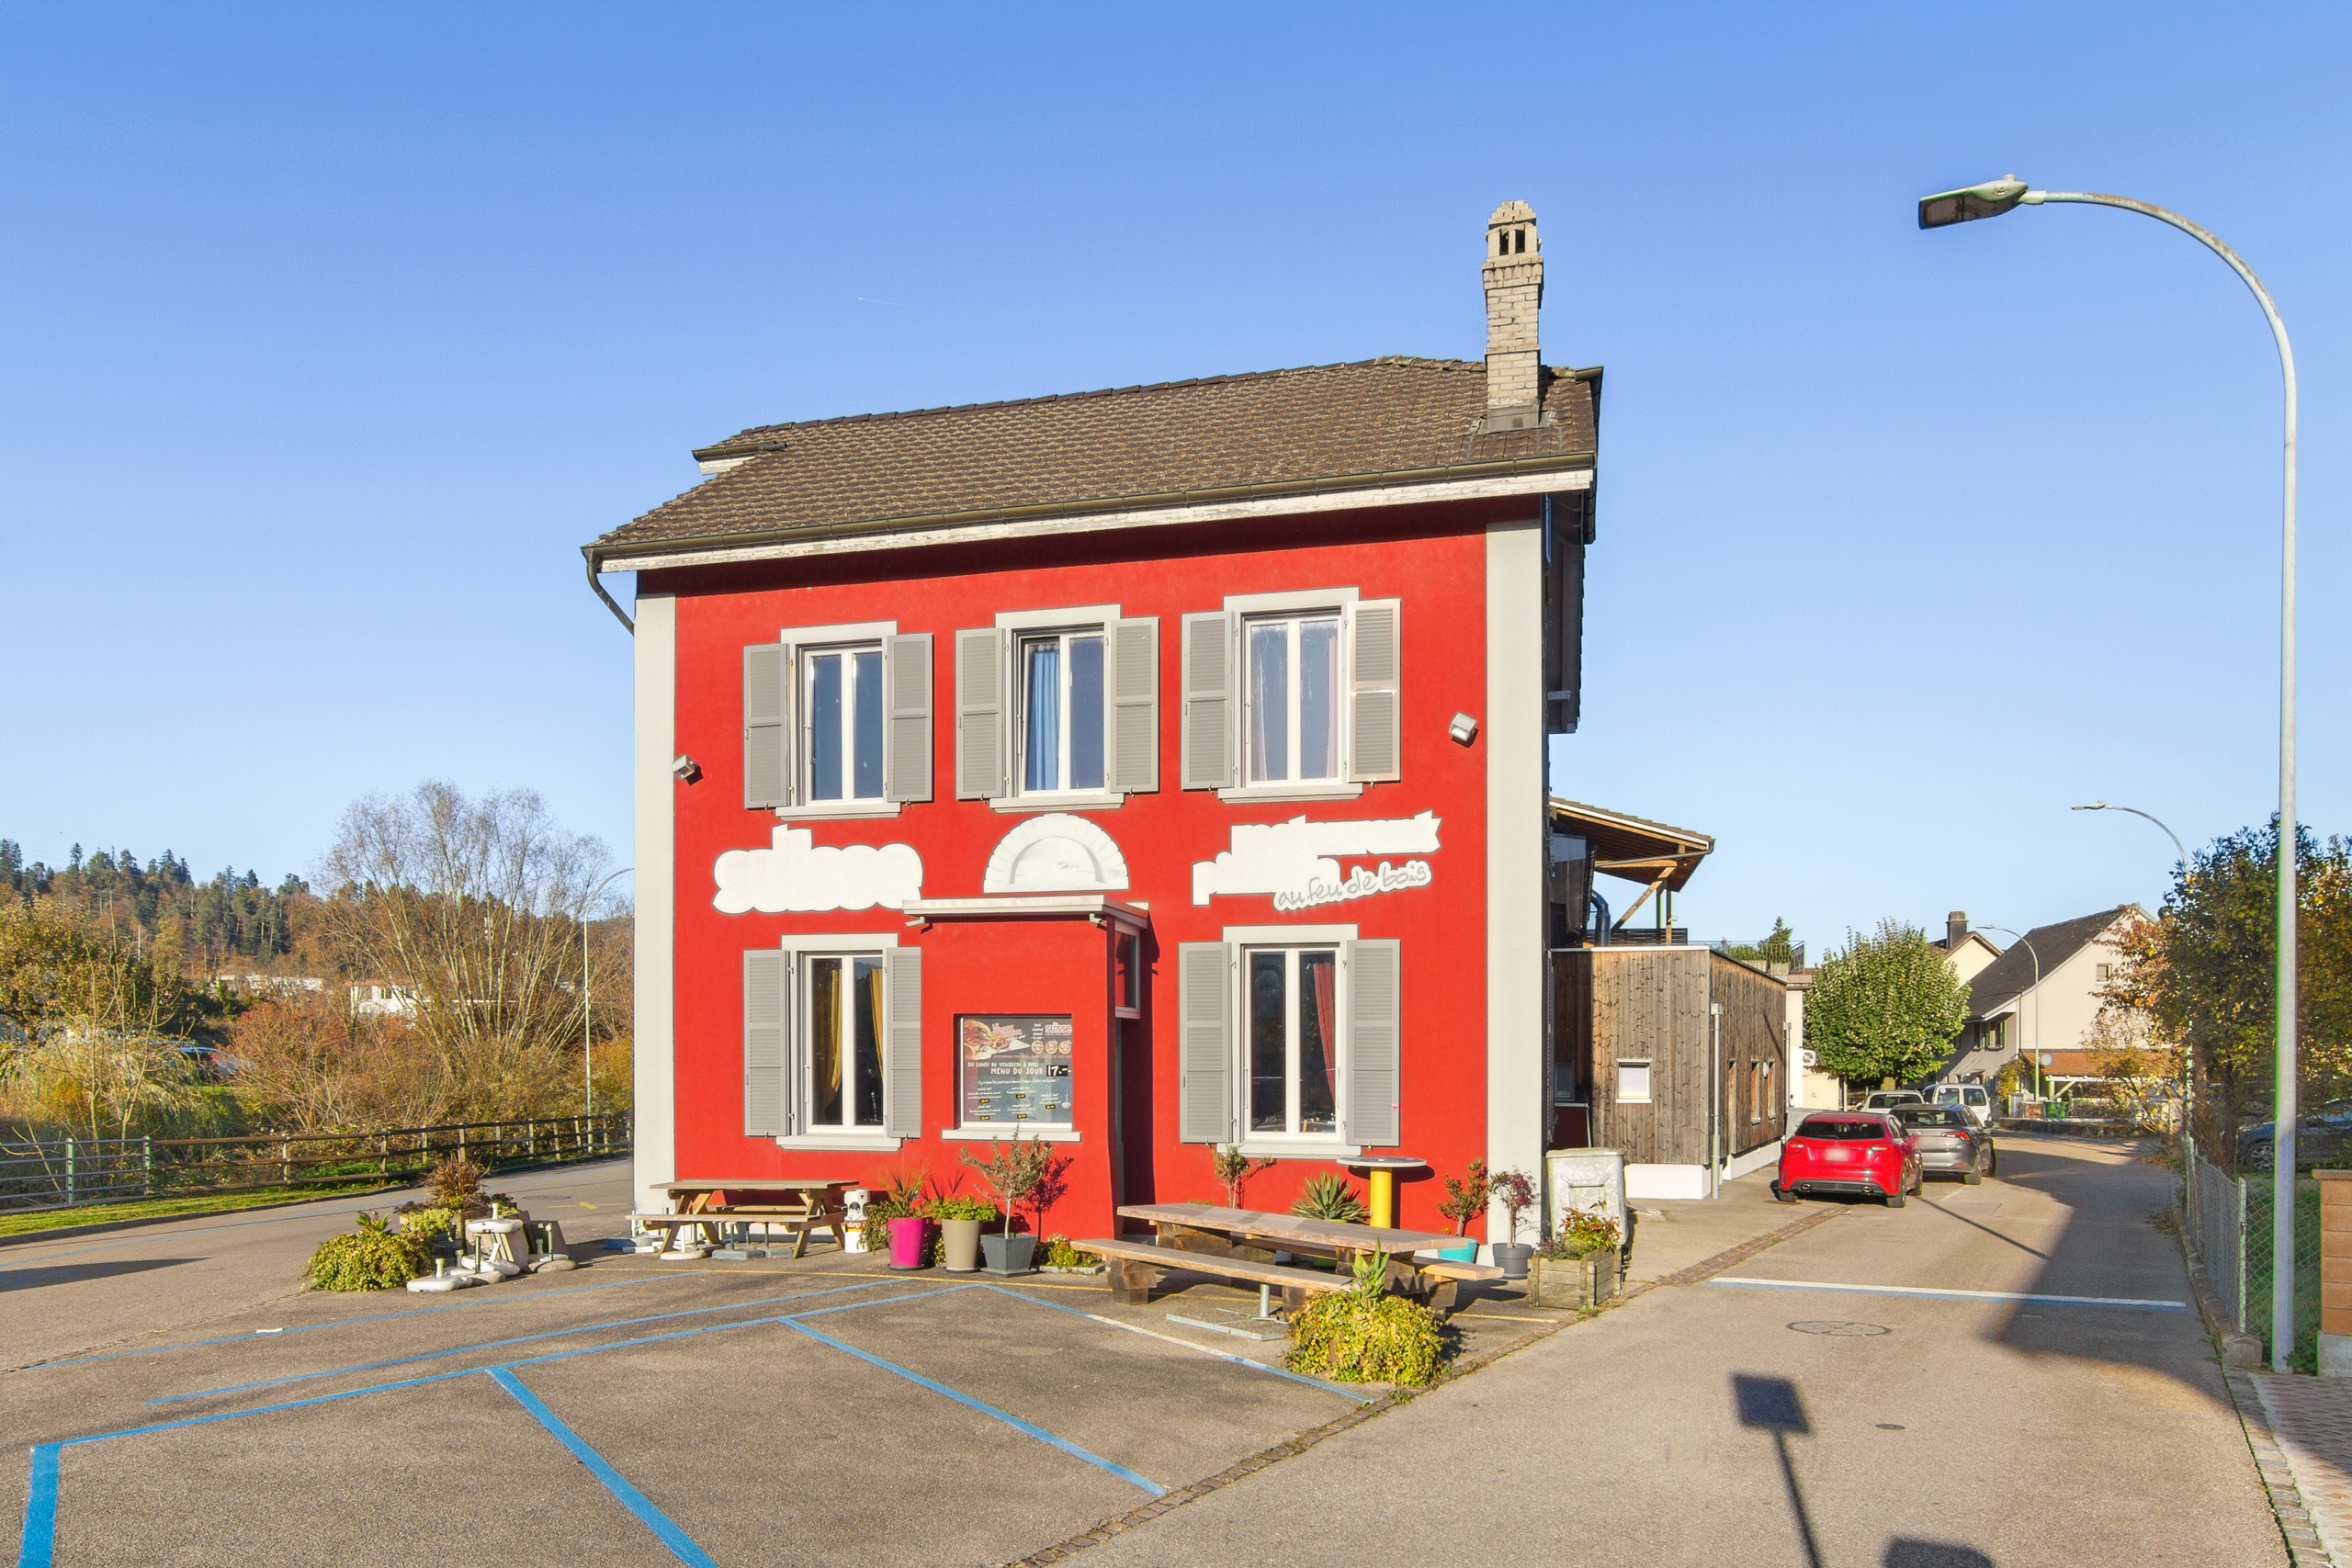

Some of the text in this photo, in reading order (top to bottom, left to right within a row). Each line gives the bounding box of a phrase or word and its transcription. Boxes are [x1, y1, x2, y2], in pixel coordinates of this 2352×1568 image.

[1278, 864, 1428, 907] au feu de bois
